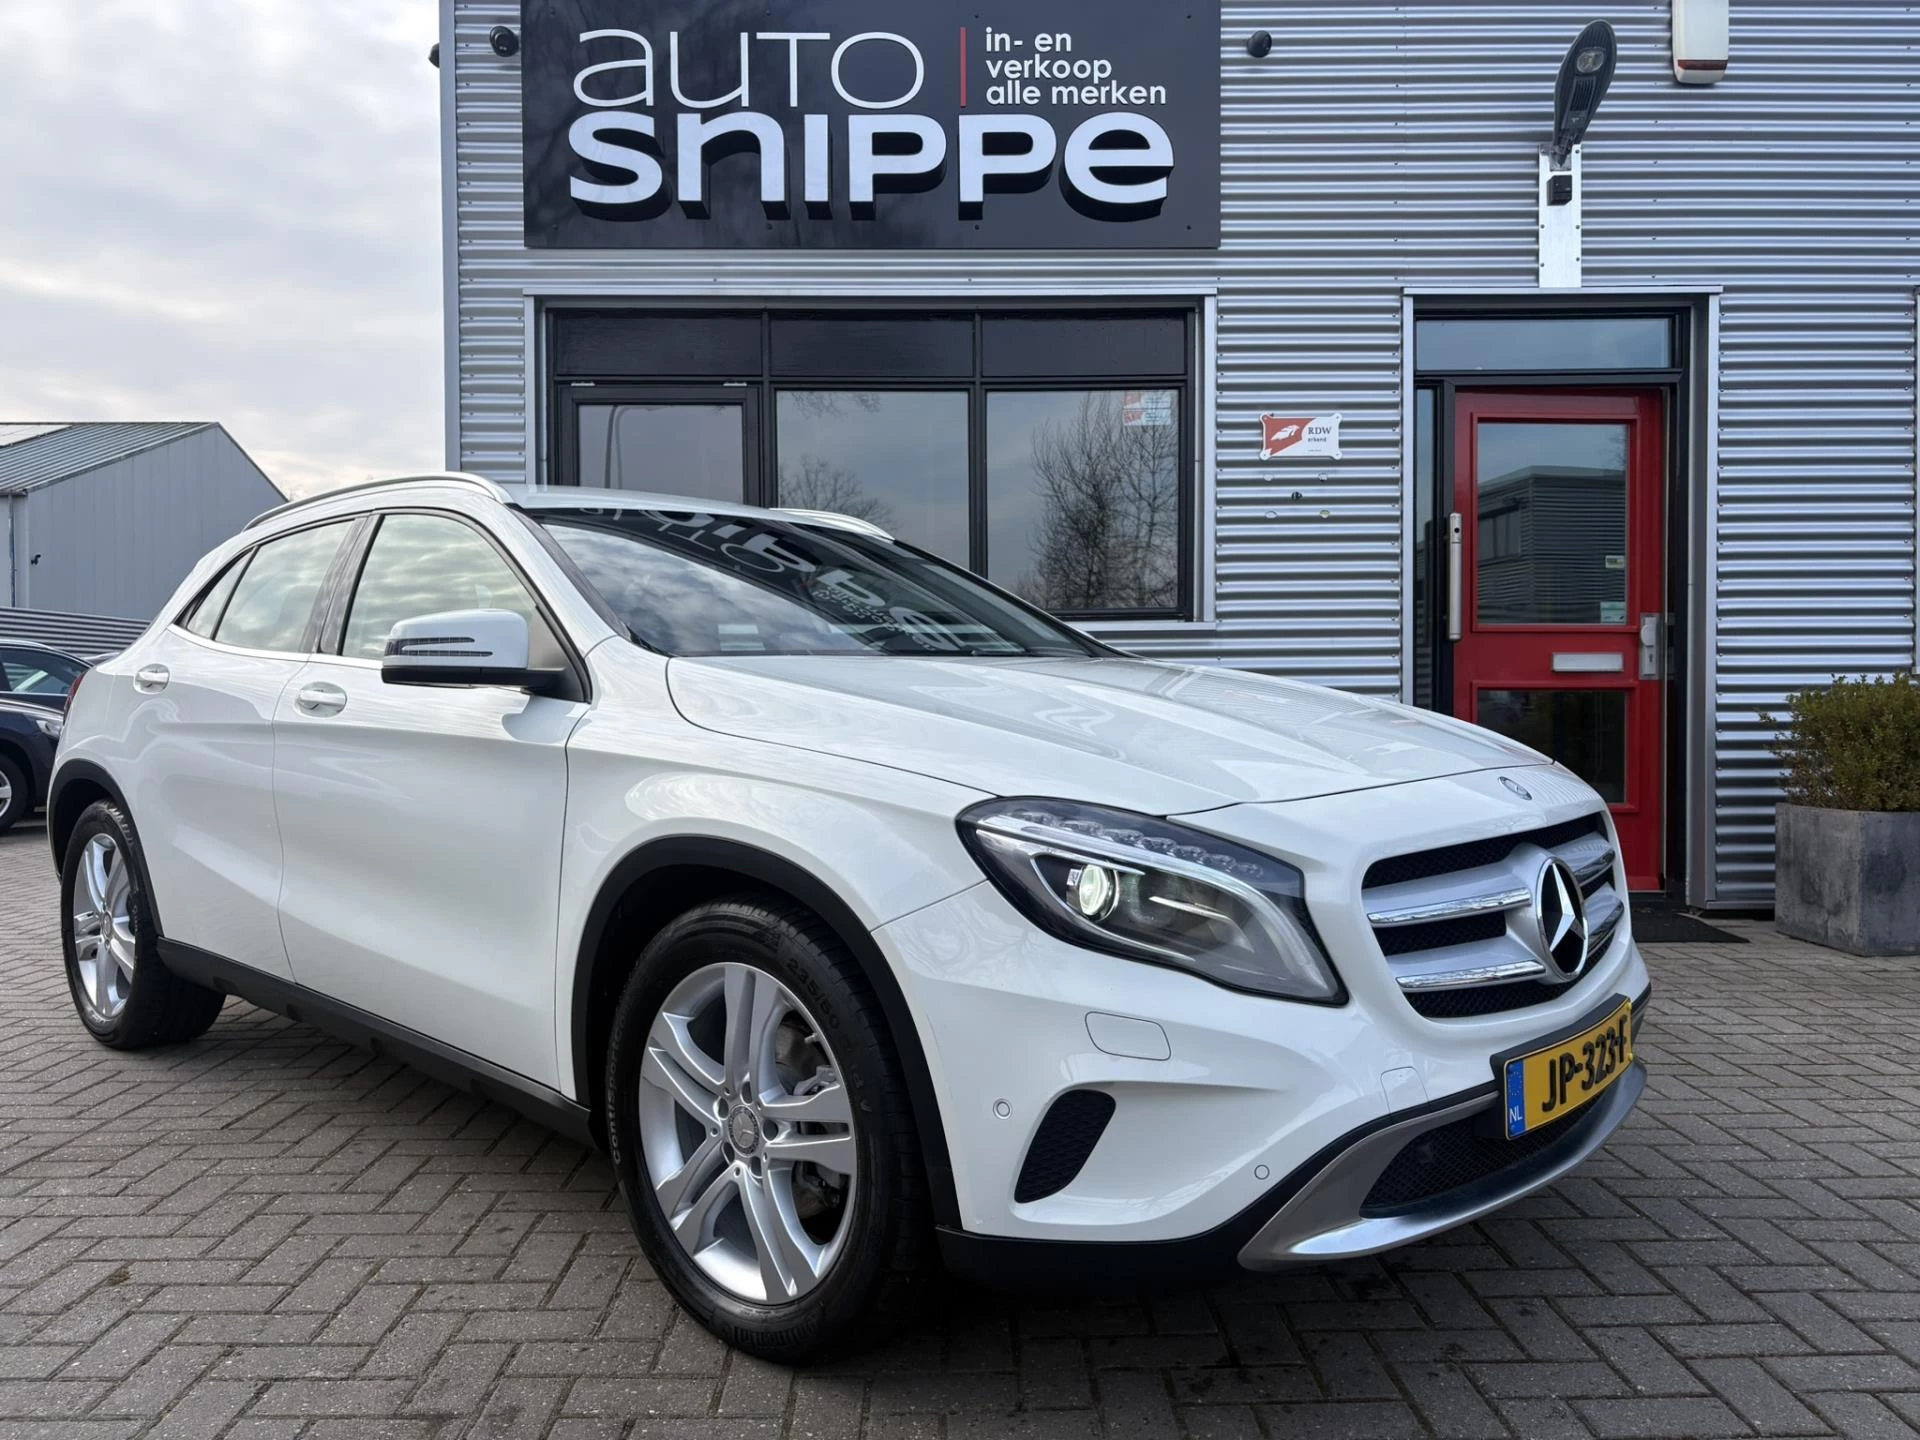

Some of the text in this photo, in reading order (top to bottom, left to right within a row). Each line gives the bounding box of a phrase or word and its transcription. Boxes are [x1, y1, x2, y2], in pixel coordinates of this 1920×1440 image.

[985, 26, 1072, 52] in- en
[985, 53, 1112, 84] verkoop
[986, 79, 1167, 105] alle merken
[1307, 426, 1332, 435] RDW
[1509, 1107, 1523, 1124] NL
